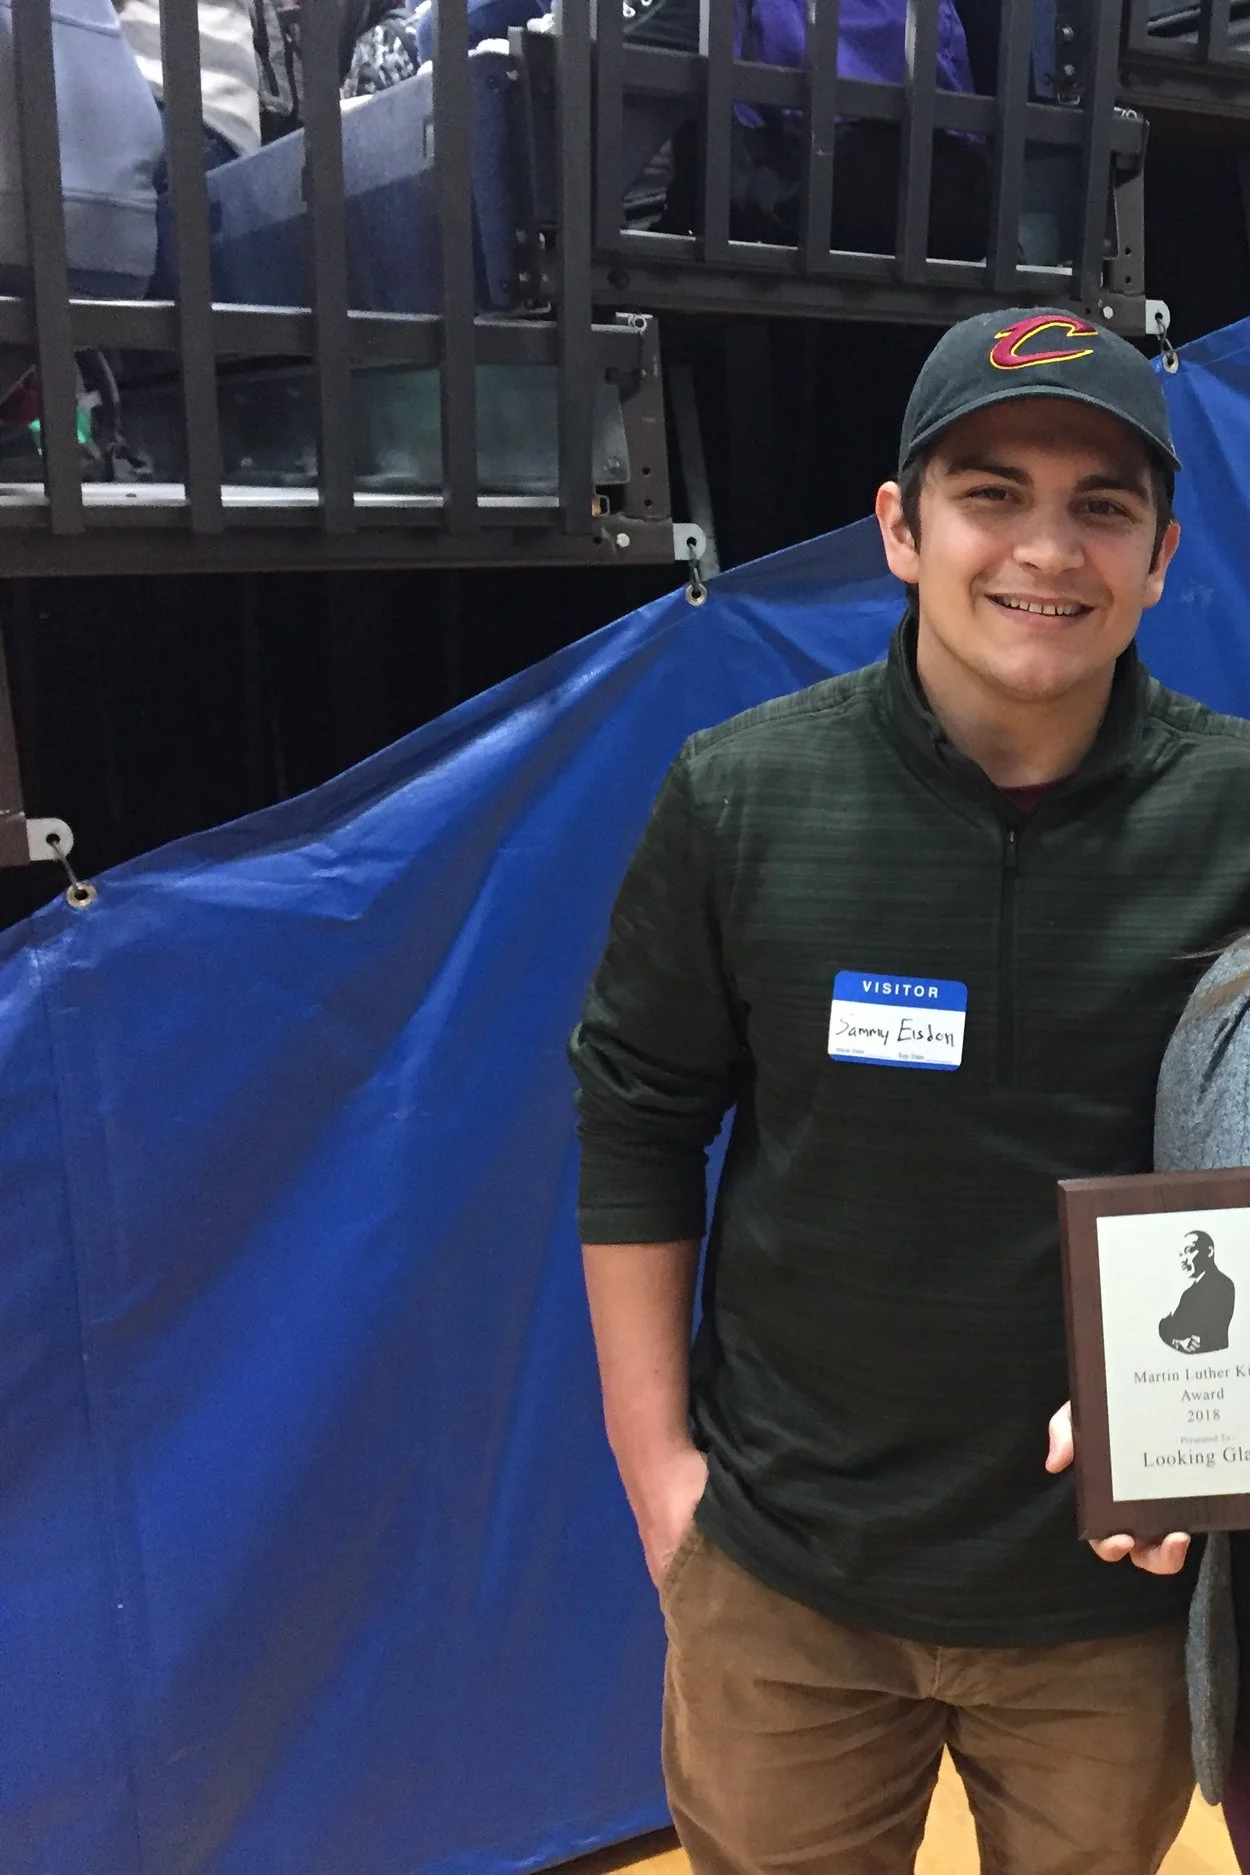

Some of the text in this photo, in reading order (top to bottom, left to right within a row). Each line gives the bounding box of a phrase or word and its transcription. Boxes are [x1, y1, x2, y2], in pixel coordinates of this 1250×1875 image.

[862, 980, 939, 999] VISITOR
[835, 1013, 890, 1046] Sammy
[1134, 1370, 1180, 1384] Martin
[1185, 1368, 1230, 1381] Luther
[1181, 1387, 1225, 1402] Award
[1187, 1409, 1221, 1423] 2018
[1143, 1449, 1216, 1468] Looking
